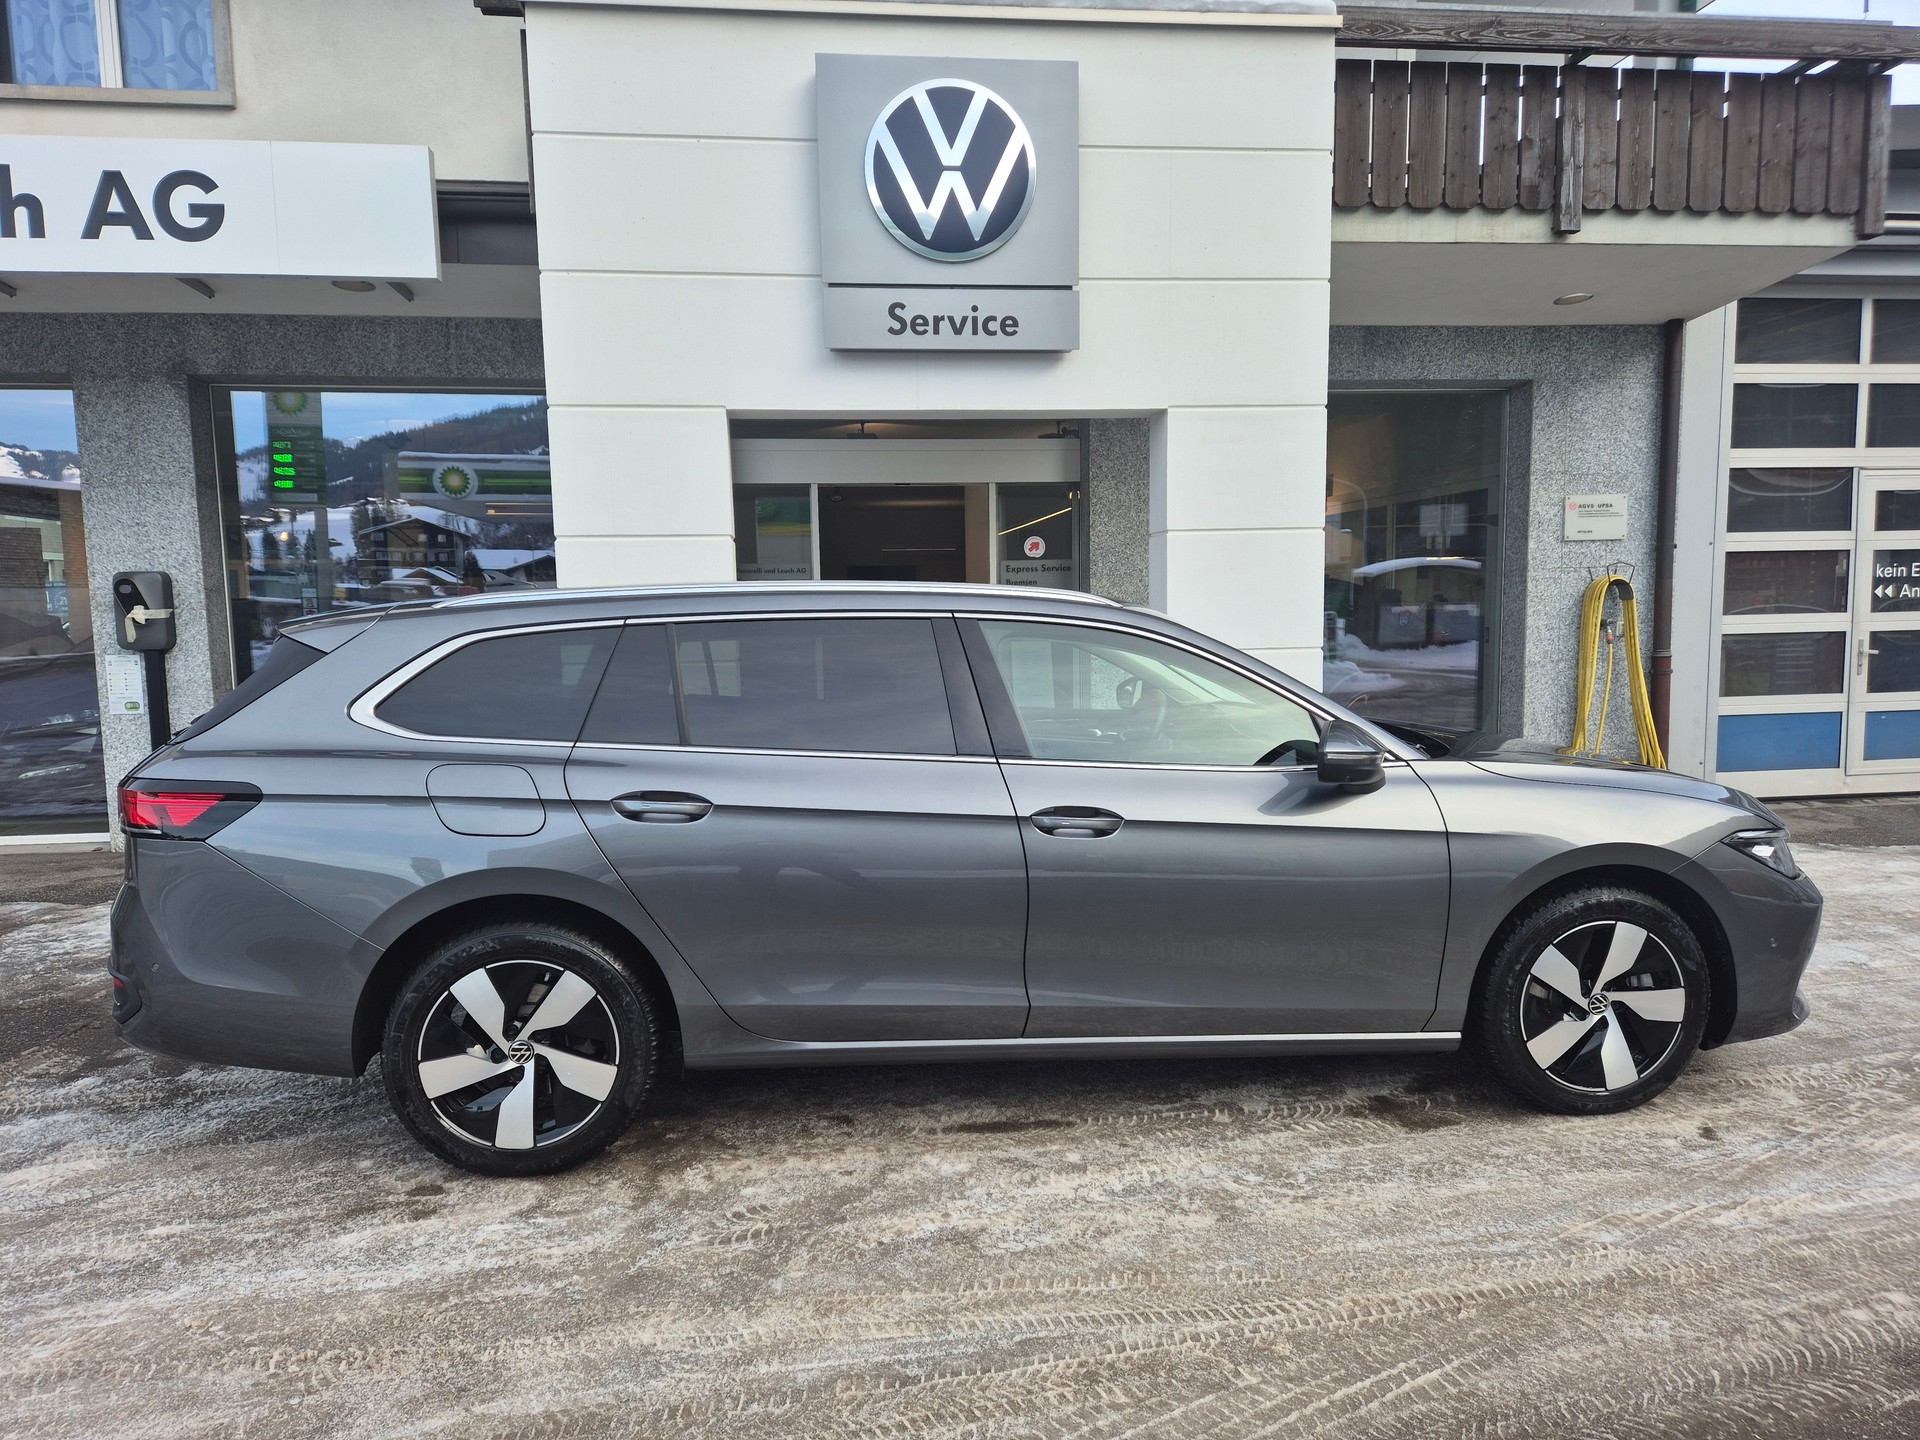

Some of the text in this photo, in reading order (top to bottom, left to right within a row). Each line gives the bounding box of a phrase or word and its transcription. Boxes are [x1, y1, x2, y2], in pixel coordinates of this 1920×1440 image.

[80, 169, 225, 243] AG
[887, 301, 1020, 337] Service
[1005, 563, 1072, 575] Express Service
[1876, 563, 1906, 578] kein
[1006, 578, 1038, 586] Bremsen
[1899, 583, 1920, 598] An
